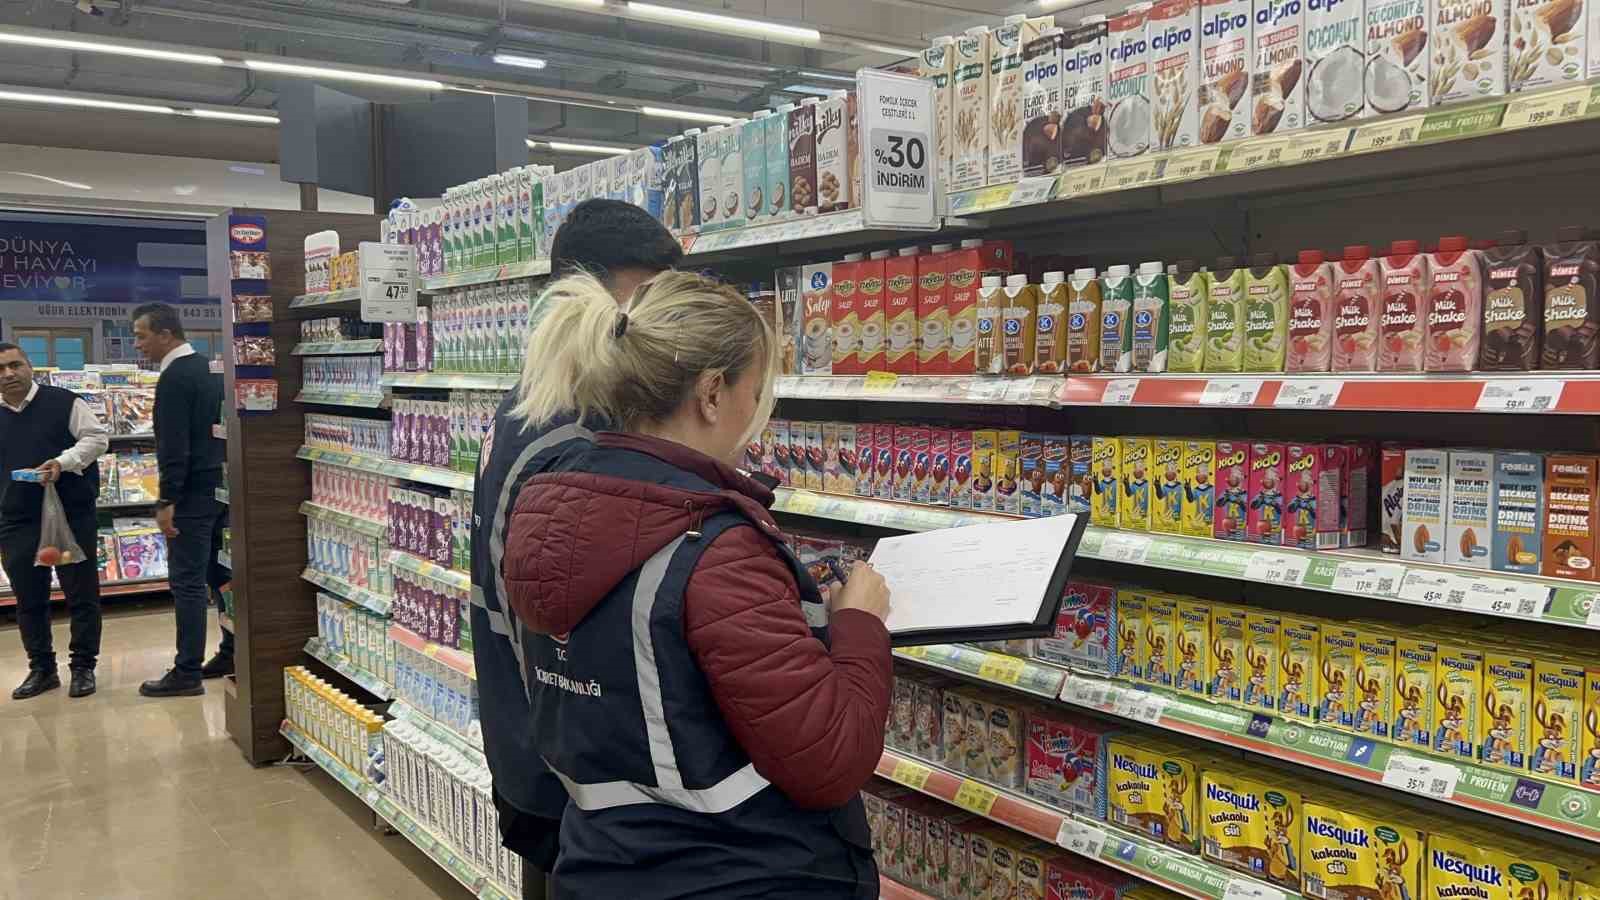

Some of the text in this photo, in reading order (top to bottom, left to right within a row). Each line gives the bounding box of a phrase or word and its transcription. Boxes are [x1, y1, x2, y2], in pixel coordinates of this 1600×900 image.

[1437, 0, 1491, 25] ALMOND
[1203, 15, 1247, 38] alpro
[1367, 15, 1424, 40] ALMOND
[1152, 28, 1192, 51] alpro
[1308, 18, 1359, 50] COCONUT
[1110, 40, 1147, 63] alpro
[1065, 51, 1102, 74] alpro
[1025, 63, 1058, 83] alpro
[875, 136, 925, 170] %30
[877, 170, 925, 189] İNDİRİM
[14, 256, 96, 273] HAVAYI
[806, 297, 830, 317] Salep
[1387, 301, 1408, 312] Milk
[1434, 299, 1456, 311] Milk
[1491, 296, 1514, 309] Milk
[1551, 294, 1576, 307] Milk
[1211, 311, 1227, 321] Milk
[1250, 310, 1267, 320] Milk
[1295, 308, 1313, 318] Milk
[1342, 305, 1361, 316] Milk
[1485, 307, 1526, 323] Shake
[1544, 306, 1588, 323] Shake
[1173, 314, 1187, 322] Milk
[1289, 318, 1321, 330] Shake
[1336, 315, 1369, 329] Shake
[1381, 312, 1416, 325] Shake
[1428, 311, 1466, 326] Shake
[1169, 322, 1195, 333] Shake
[1207, 320, 1234, 331] Shake
[1247, 319, 1274, 331] Shake
[1499, 490, 1537, 499] BECAUSE
[1550, 492, 1590, 501] BECAUSE
[1408, 503, 1440, 513] DRINK
[1454, 506, 1487, 516] DRINK
[1498, 510, 1536, 522] DRINK
[1548, 514, 1589, 525] DRINK
[1216, 616, 1242, 627] Nesquik
[1249, 623, 1275, 634] Nesquik
[1284, 628, 1312, 641] Nesquik
[1325, 635, 1355, 649] Nesquik
[1359, 642, 1390, 657] Nesquik
[1400, 649, 1432, 662] Nesquik
[1440, 657, 1475, 672] Nesquik
[1489, 665, 1526, 680] Nesquik
[558, 673, 601, 697] BAKANLIĞI
[1539, 673, 1578, 689] Nesquik
[1114, 754, 1159, 780] Nesquik
[1116, 781, 1150, 793] kakaolu
[1128, 792, 1143, 804] süt
[1206, 783, 1260, 811] Nesquik
[1209, 812, 1249, 825] kakaolu
[1224, 824, 1241, 837] süt
[1307, 815, 1369, 848] Nesquik
[1310, 848, 1357, 861] kakaolu
[1326, 860, 1348, 875] süt
[1432, 849, 1503, 887] Nesquik
[1203, 874, 1225, 889] PROTE
[1436, 884, 1489, 900] kakaolu
